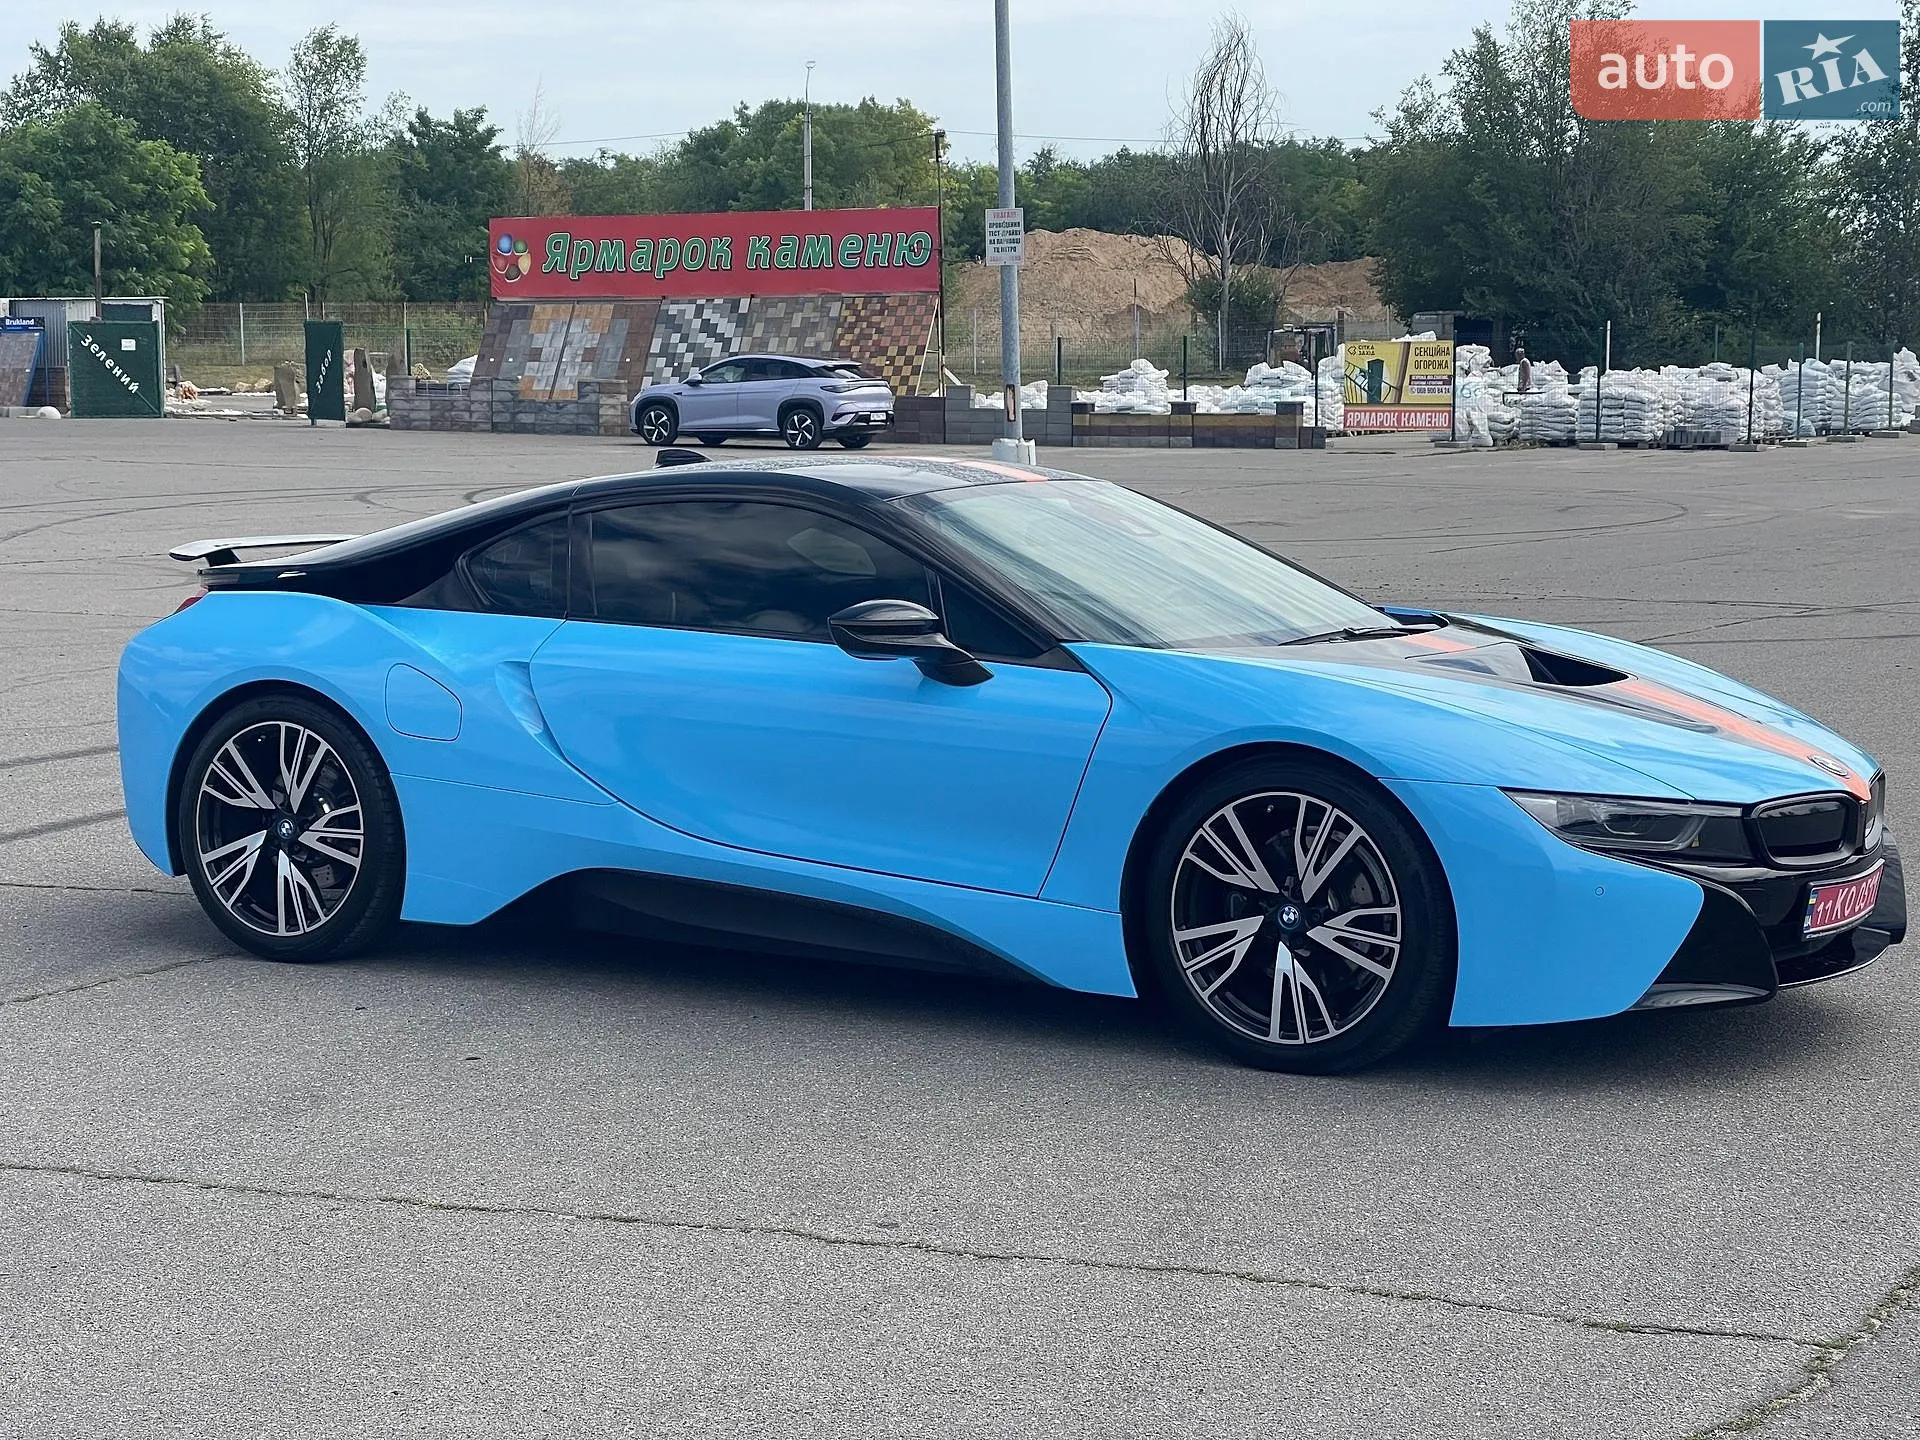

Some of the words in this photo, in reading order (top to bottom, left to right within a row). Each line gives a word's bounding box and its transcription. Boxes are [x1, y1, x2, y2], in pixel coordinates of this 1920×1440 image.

[541, 231, 735, 281] Ярмарок
[745, 229, 933, 271] каменю
[1414, 345, 1451, 357] СЕКЦІЙНА
[80, 334, 139, 394] Зелений
[1414, 359, 1449, 370] ОГОРОЖА
[1346, 411, 1399, 427] ЯРМАРОК
[1401, 411, 1449, 427] КАМЕНЮ
